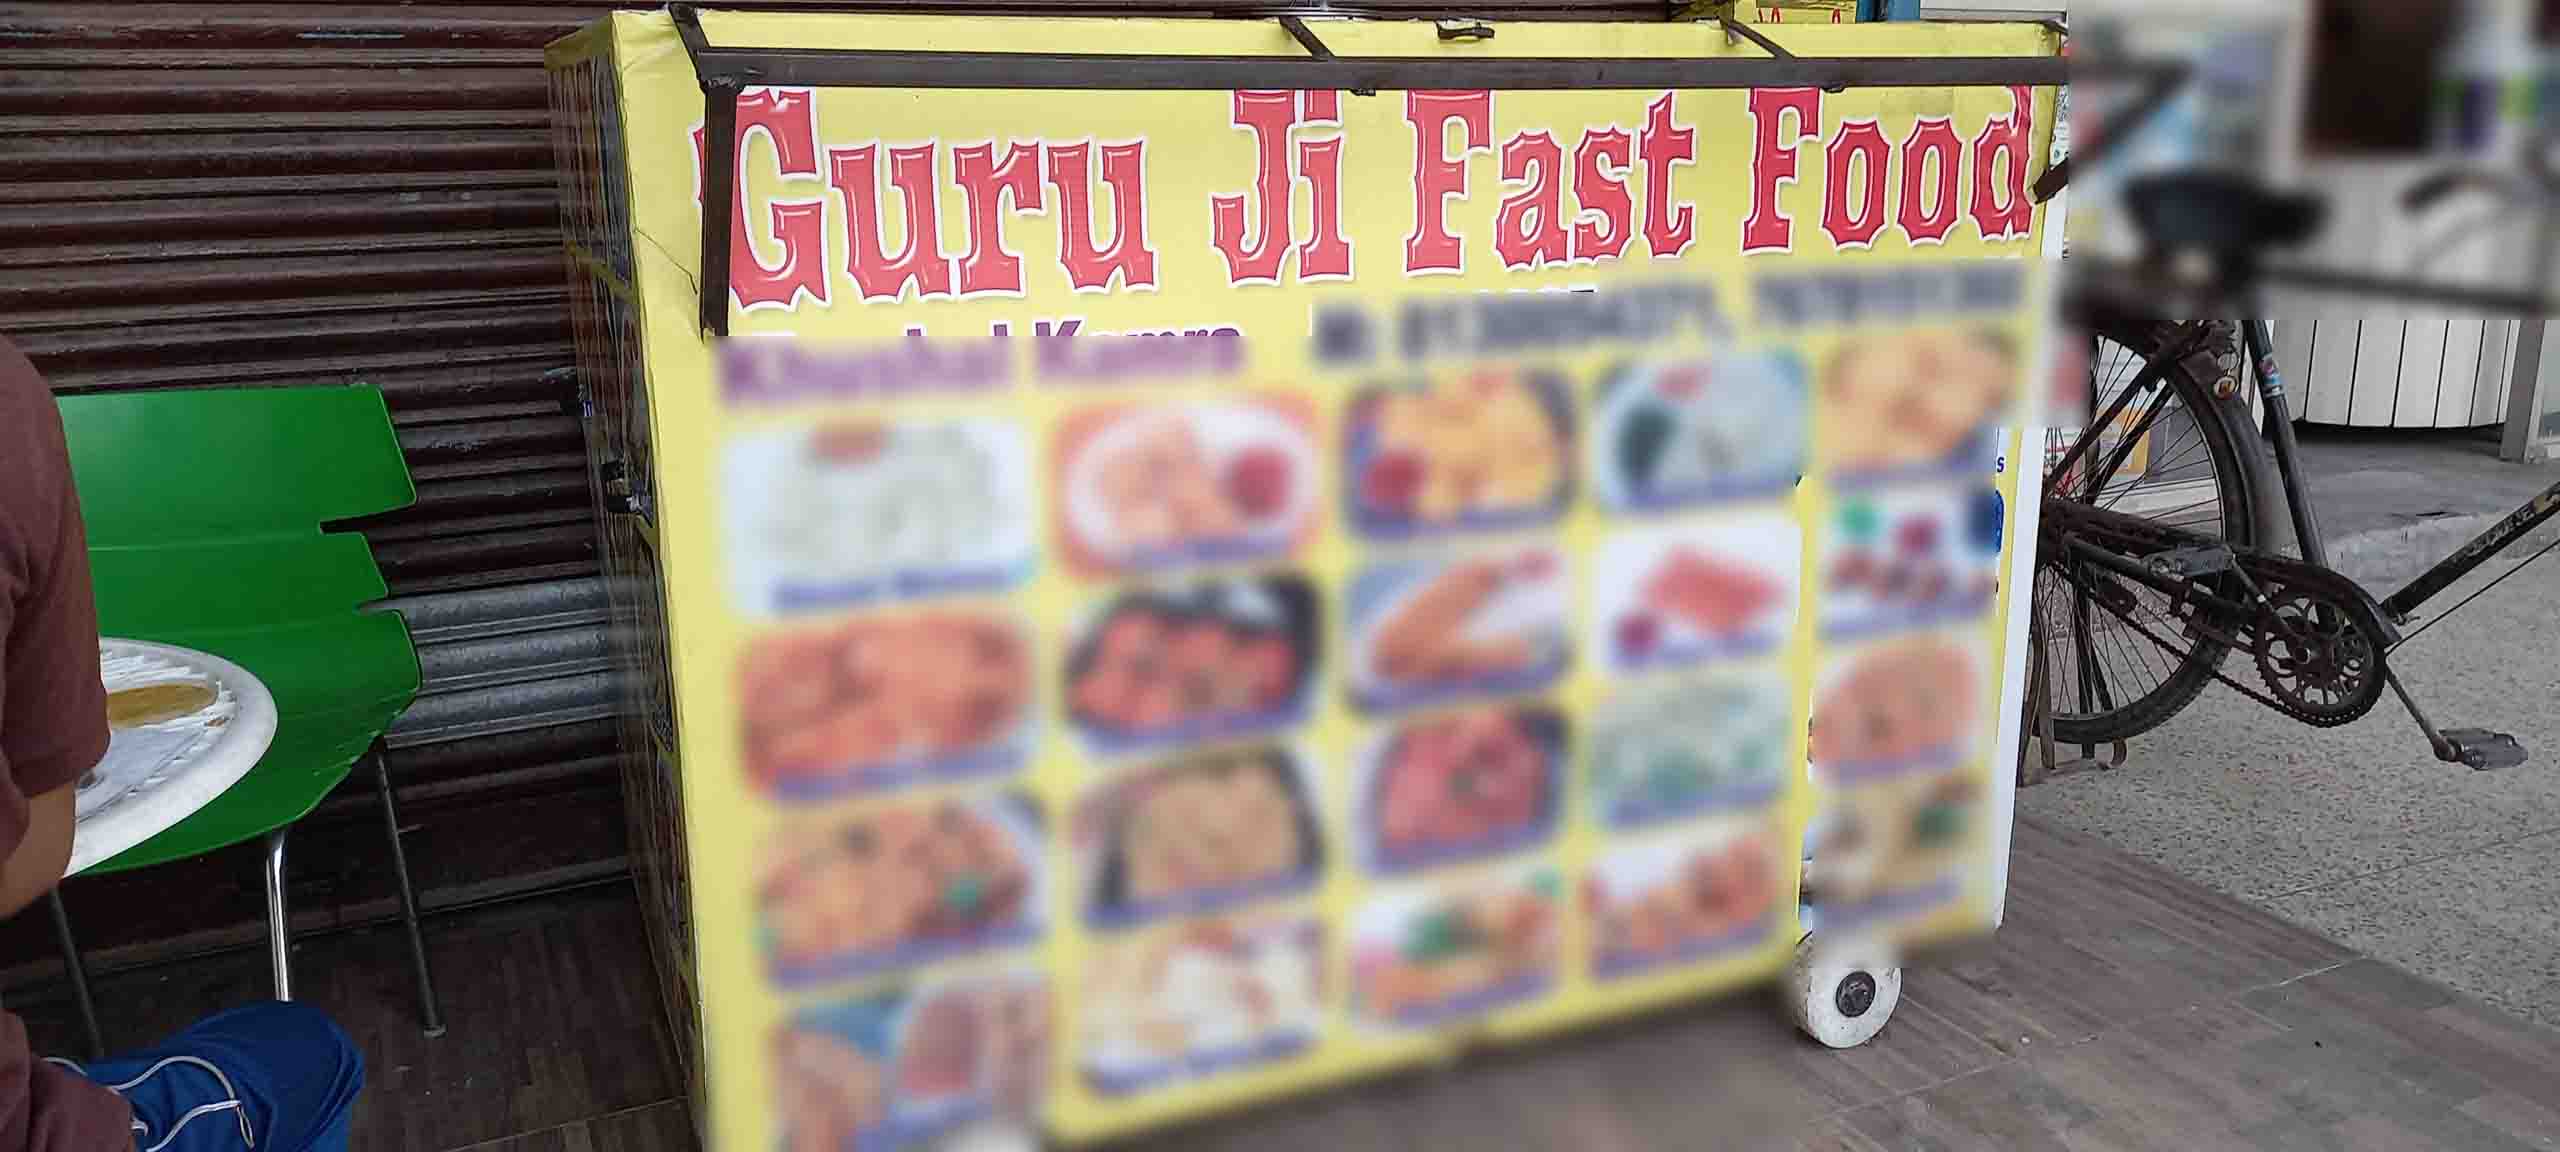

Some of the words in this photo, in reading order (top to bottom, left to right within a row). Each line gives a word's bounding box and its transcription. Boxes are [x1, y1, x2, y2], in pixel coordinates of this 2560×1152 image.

[691, 87, 1156, 308] Guru
[1211, 88, 1351, 284] Ji
[1405, 87, 1695, 271] Fast
[1742, 86, 2034, 250] Food
